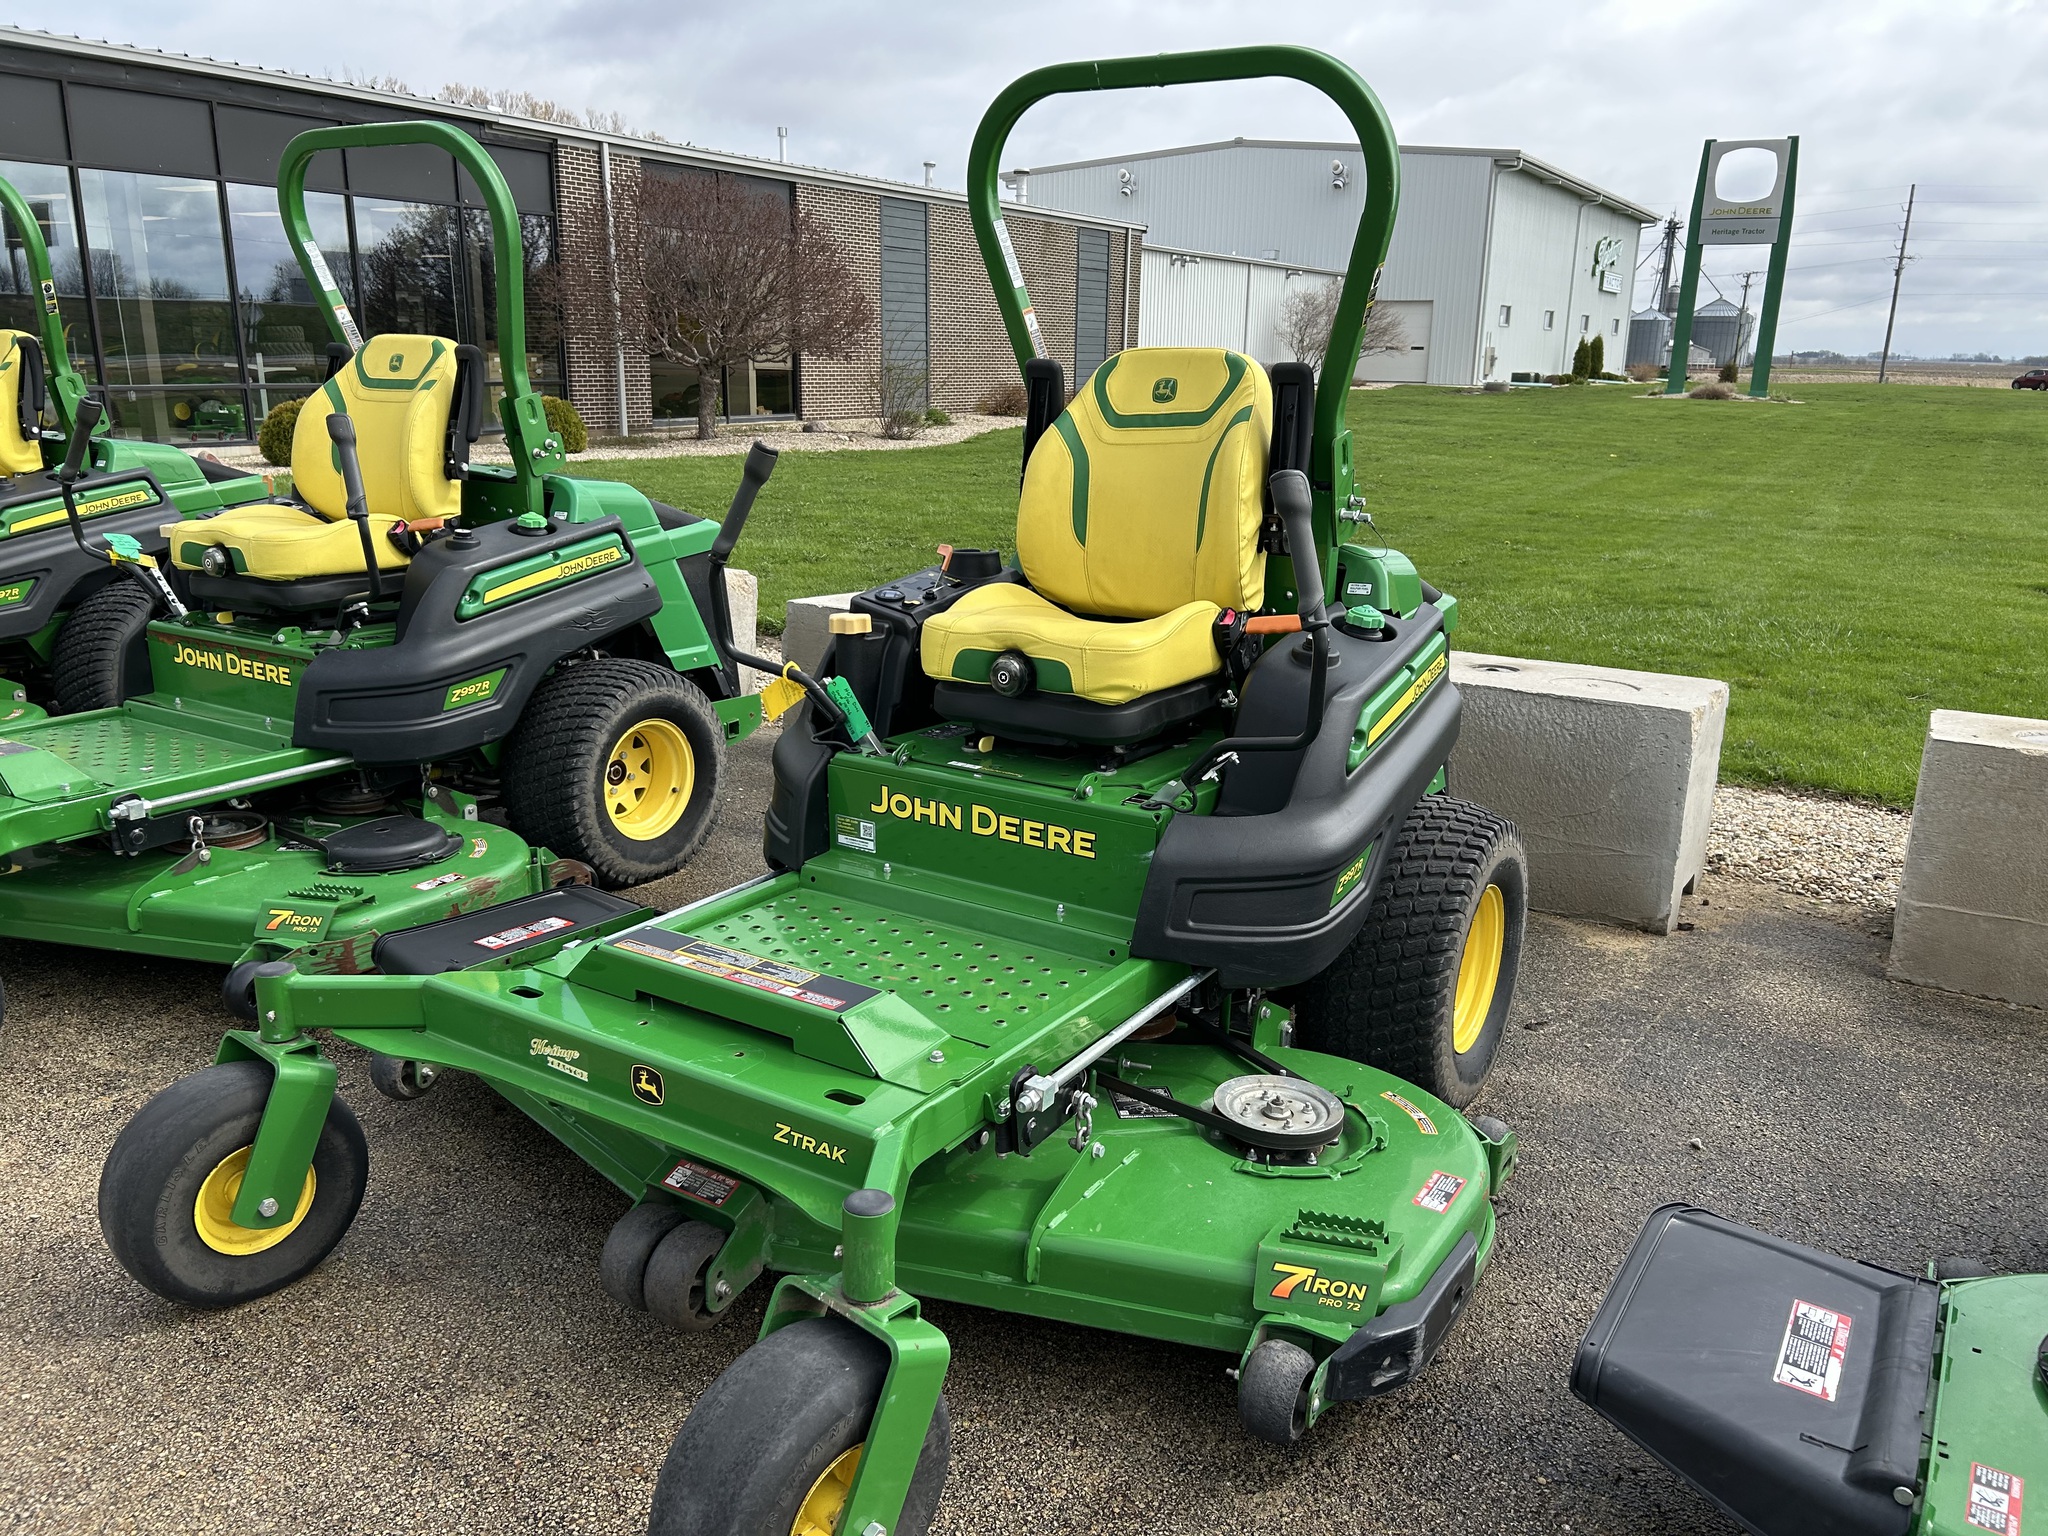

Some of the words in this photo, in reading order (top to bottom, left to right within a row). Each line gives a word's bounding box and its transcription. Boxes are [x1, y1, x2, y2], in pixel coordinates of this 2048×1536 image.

[1709, 208, 1736, 216] JOHN
[1738, 207, 1773, 215] DEERE
[83, 502, 110, 514] JOHN
[110, 493, 142, 507] DEERE
[556, 564, 584, 580] JOHN
[585, 551, 616, 569] DEERE
[174, 642, 223, 672] JOHN
[225, 652, 292, 687] DEERE
[451, 680, 490, 703] Z997R
[1411, 678, 1428, 703] JOHN
[870, 784, 962, 831] JOHN
[970, 803, 1097, 859] DEERE
[773, 1122, 848, 1164] ZTRAK
[1318, 1296, 1343, 1309] PRO
[1346, 1301, 1361, 1312] 72
